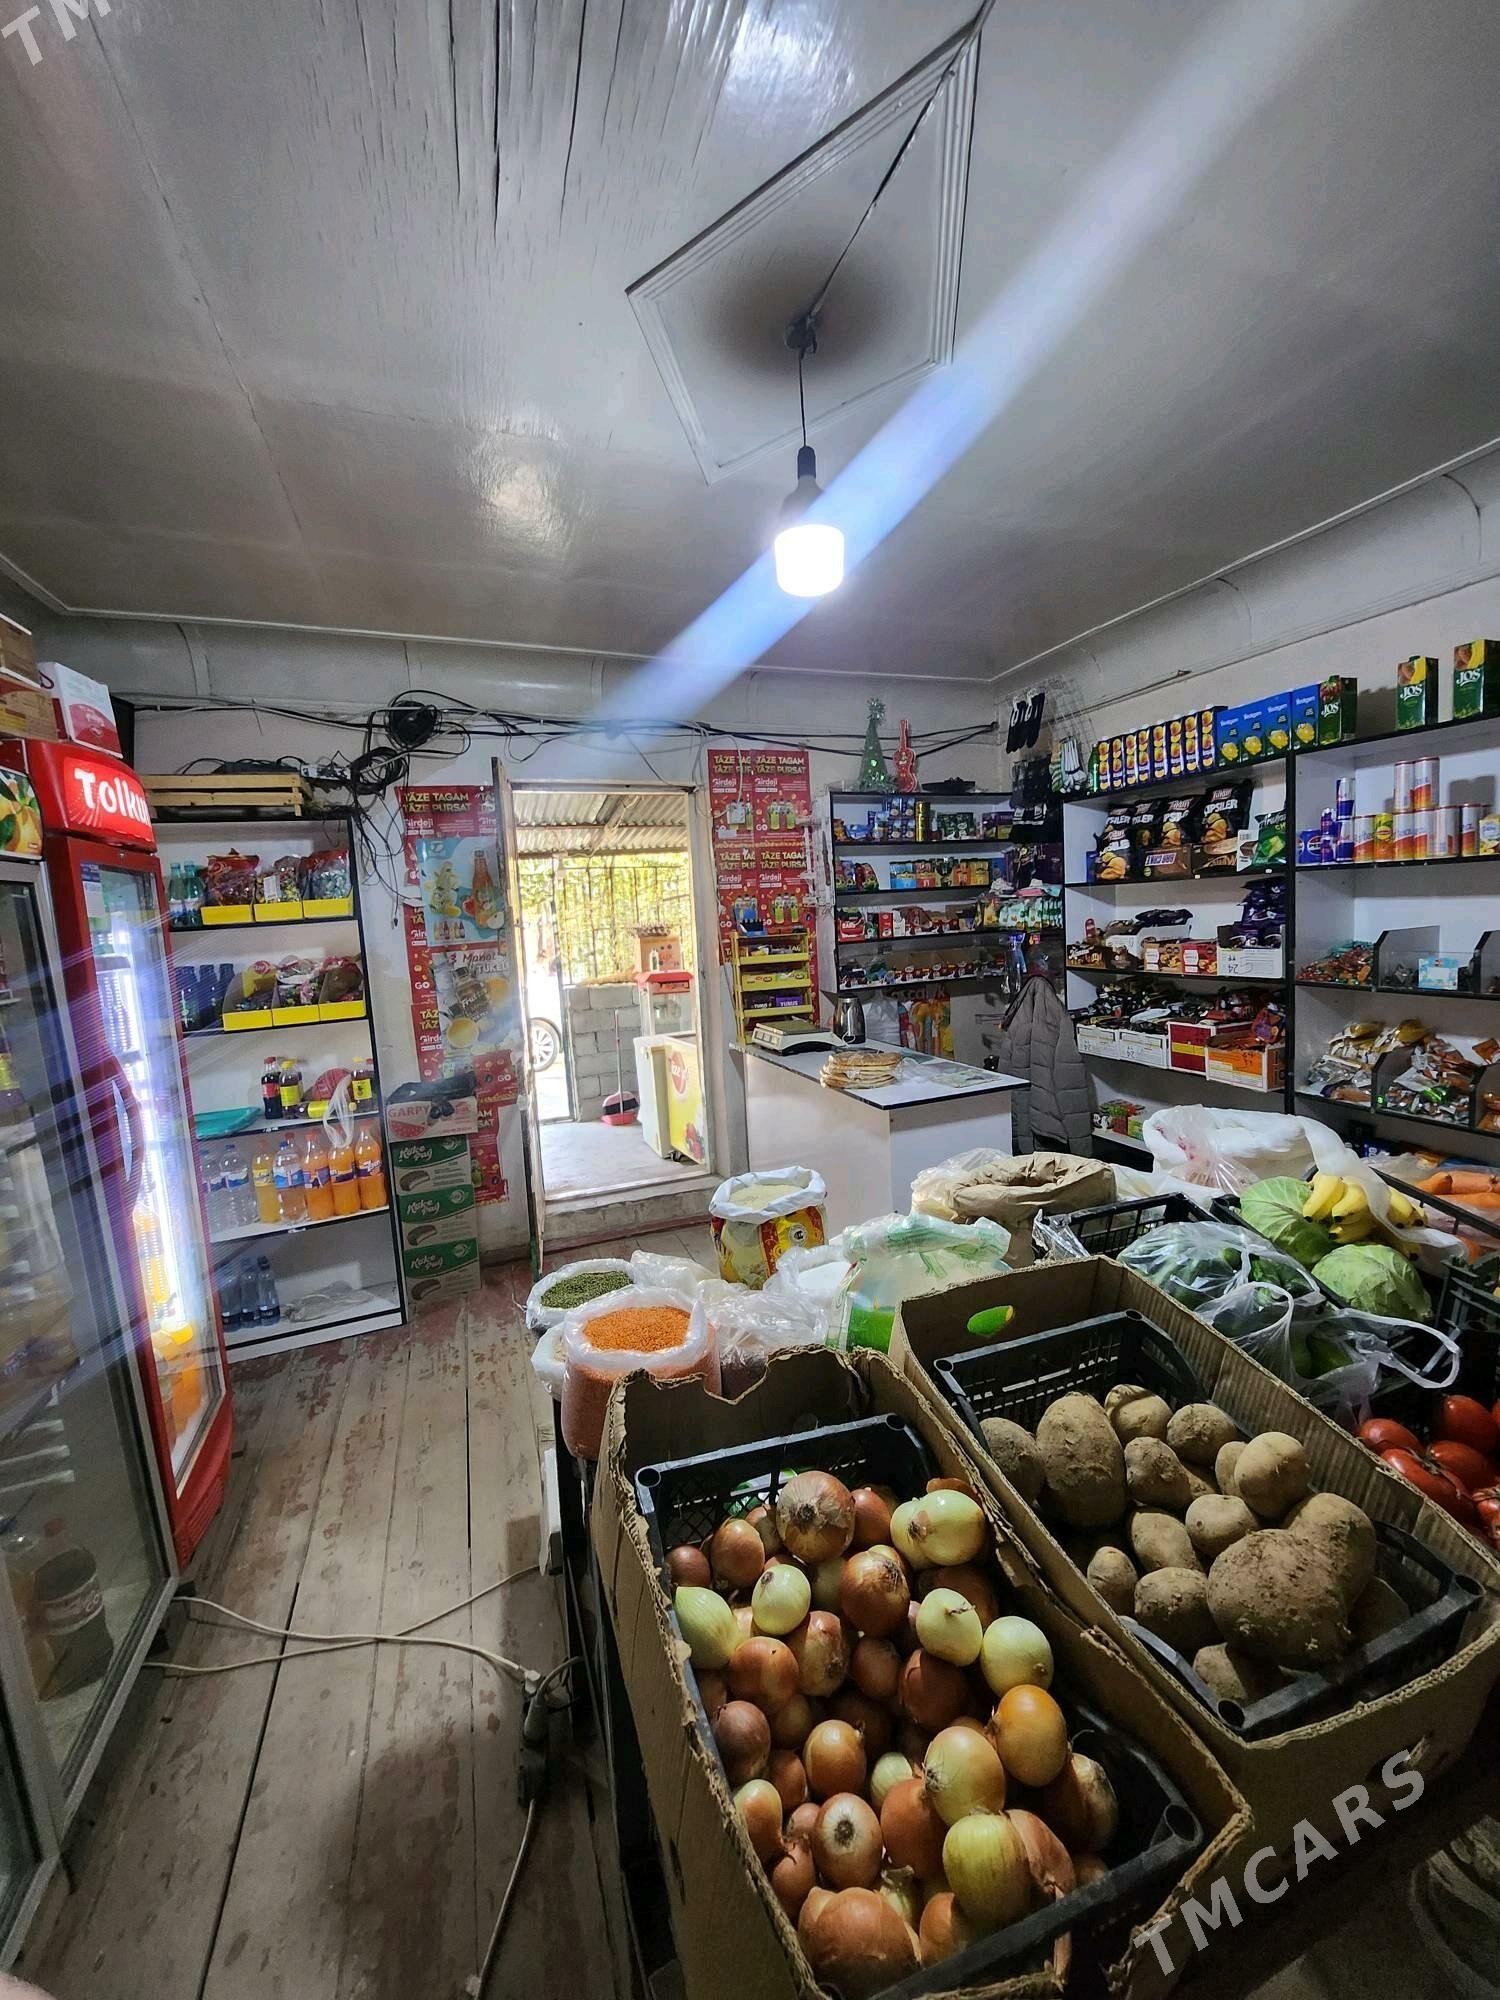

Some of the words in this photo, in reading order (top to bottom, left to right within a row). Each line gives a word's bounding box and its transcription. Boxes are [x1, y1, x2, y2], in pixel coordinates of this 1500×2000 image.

[1456, 669, 1480, 686] JOS
[1400, 684, 1422, 700] JOS
[1321, 702, 1339, 717] JOS
[778, 757, 804, 765] TAGAM
[432, 793, 469, 801] TAGAM
[781, 861, 807, 869] PURSA
[415, 982, 430, 990] GO
[498, 1074, 511, 1082] GO
[388, 1105, 430, 1118] GARPY
